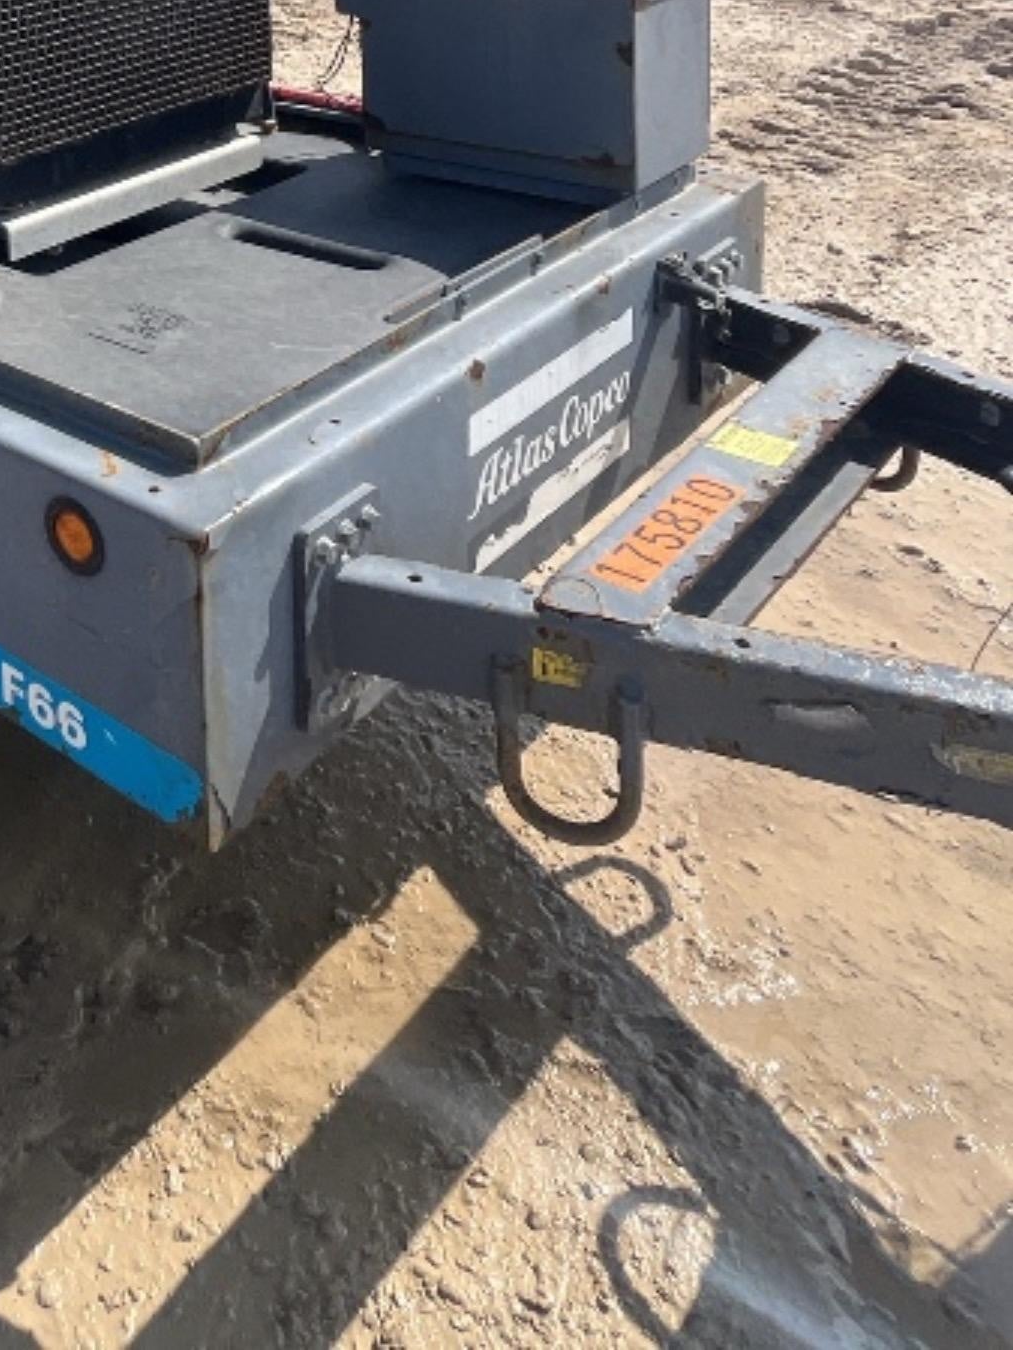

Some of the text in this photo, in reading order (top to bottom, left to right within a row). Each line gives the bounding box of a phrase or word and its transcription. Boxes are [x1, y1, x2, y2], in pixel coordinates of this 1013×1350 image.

[467, 424, 558, 522] Atlas
[559, 370, 631, 448] Copco
[595, 477, 736, 583] 175810
[1, 660, 88, 750] F66
